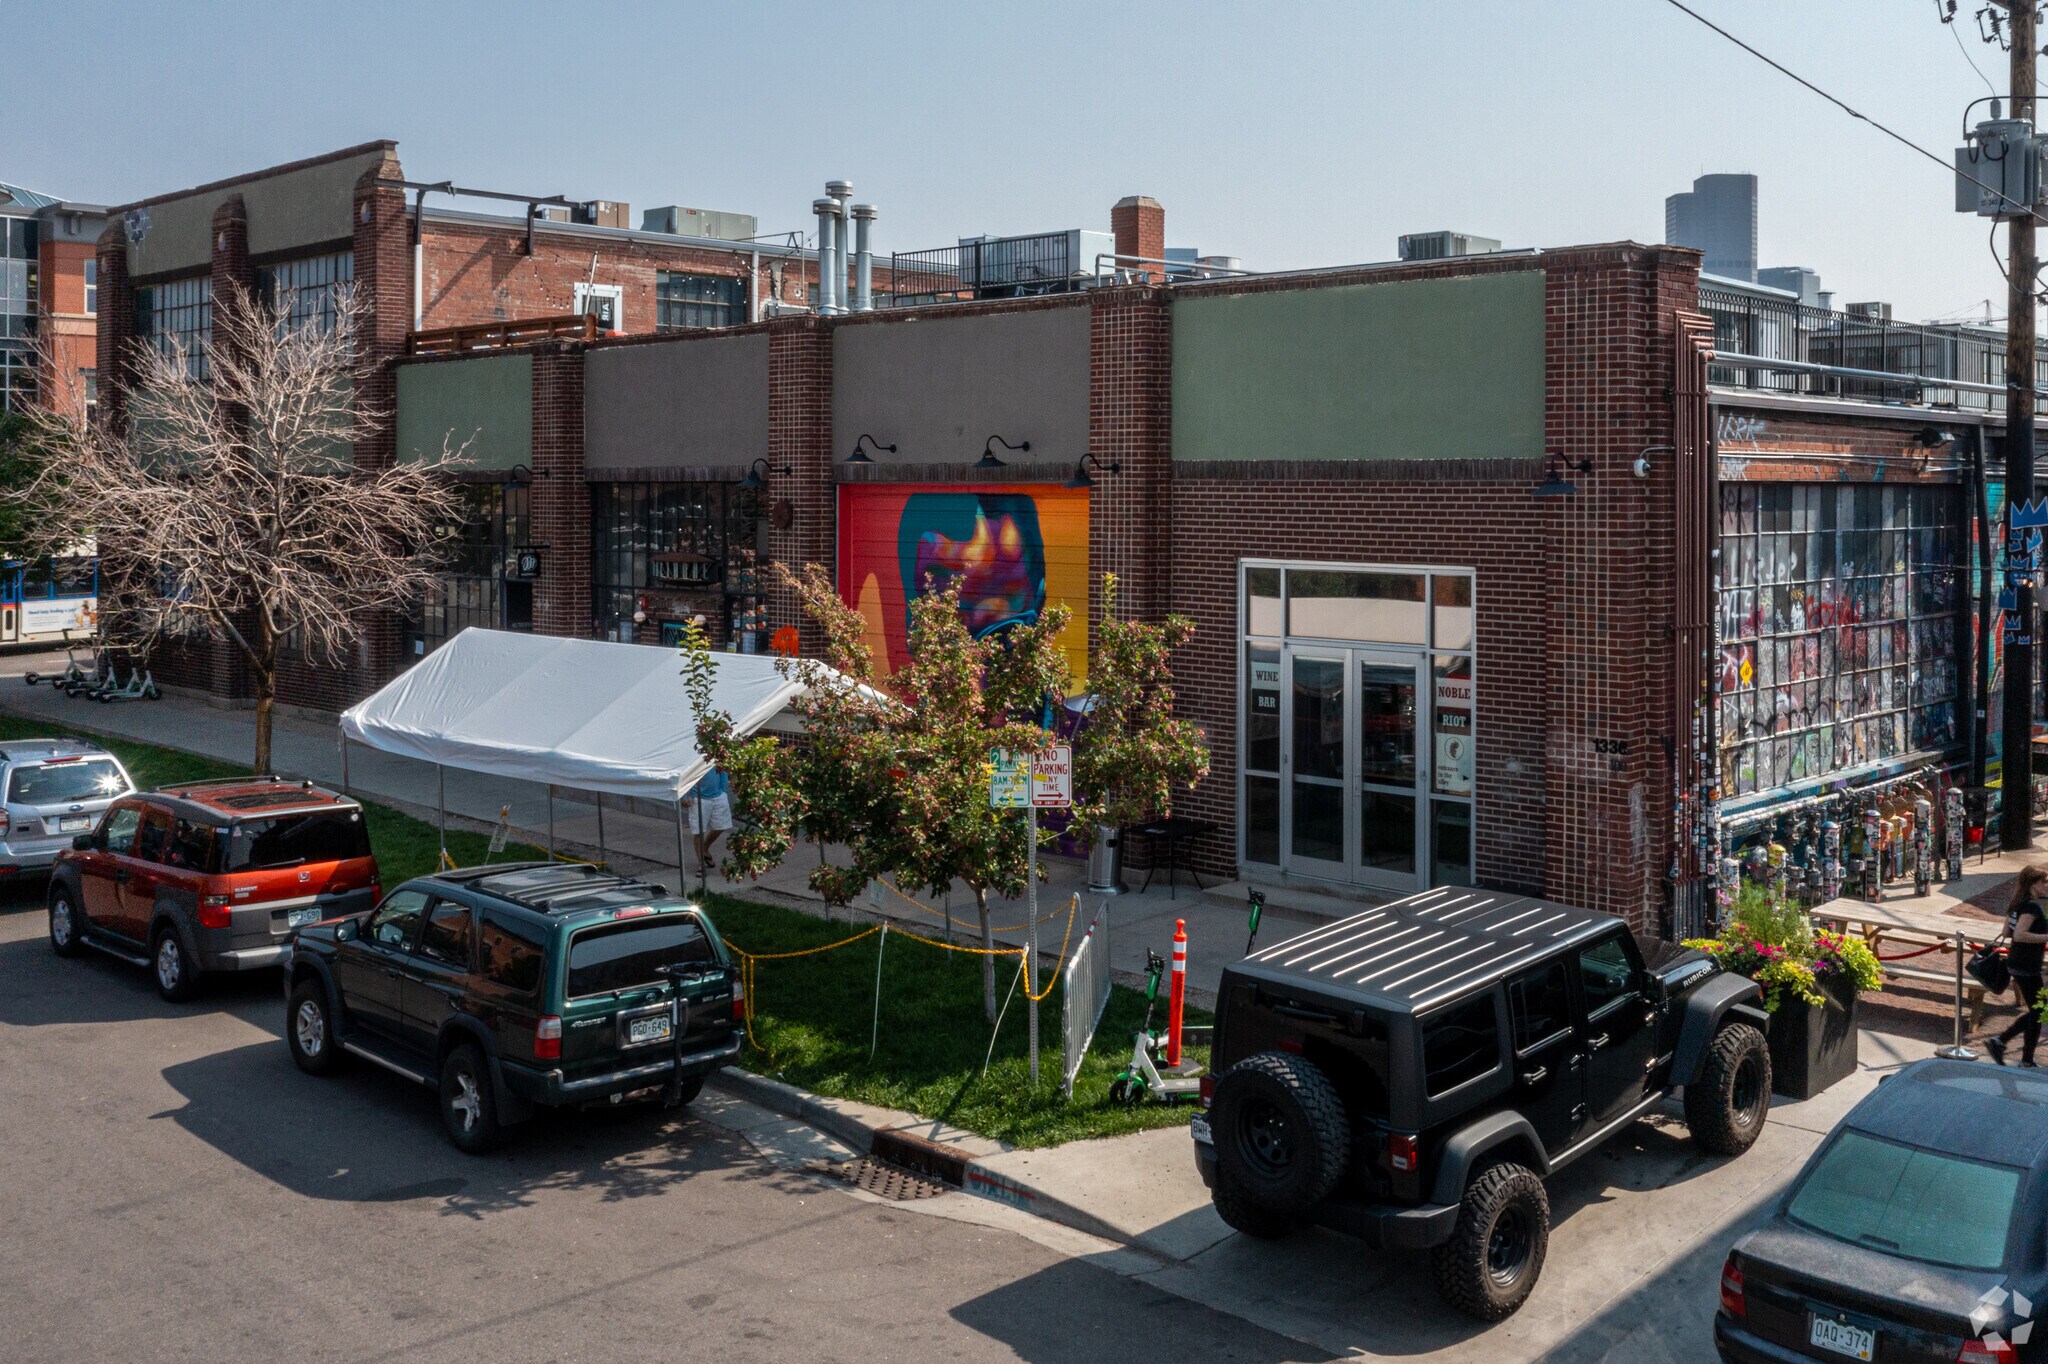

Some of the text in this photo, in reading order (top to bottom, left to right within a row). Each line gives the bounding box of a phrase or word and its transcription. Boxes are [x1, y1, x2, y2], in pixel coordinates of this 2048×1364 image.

[1255, 670, 1278, 682] WINE
[1438, 686, 1470, 699] NOBLE
[1258, 696, 1276, 708] BAR
[1442, 714, 1467, 727] RIOT
[1043, 750, 1058, 761] NO
[1034, 763, 1067, 774] PARKING
[1042, 783, 1059, 791] TIME
[1683, 964, 1712, 988] RUBICON
